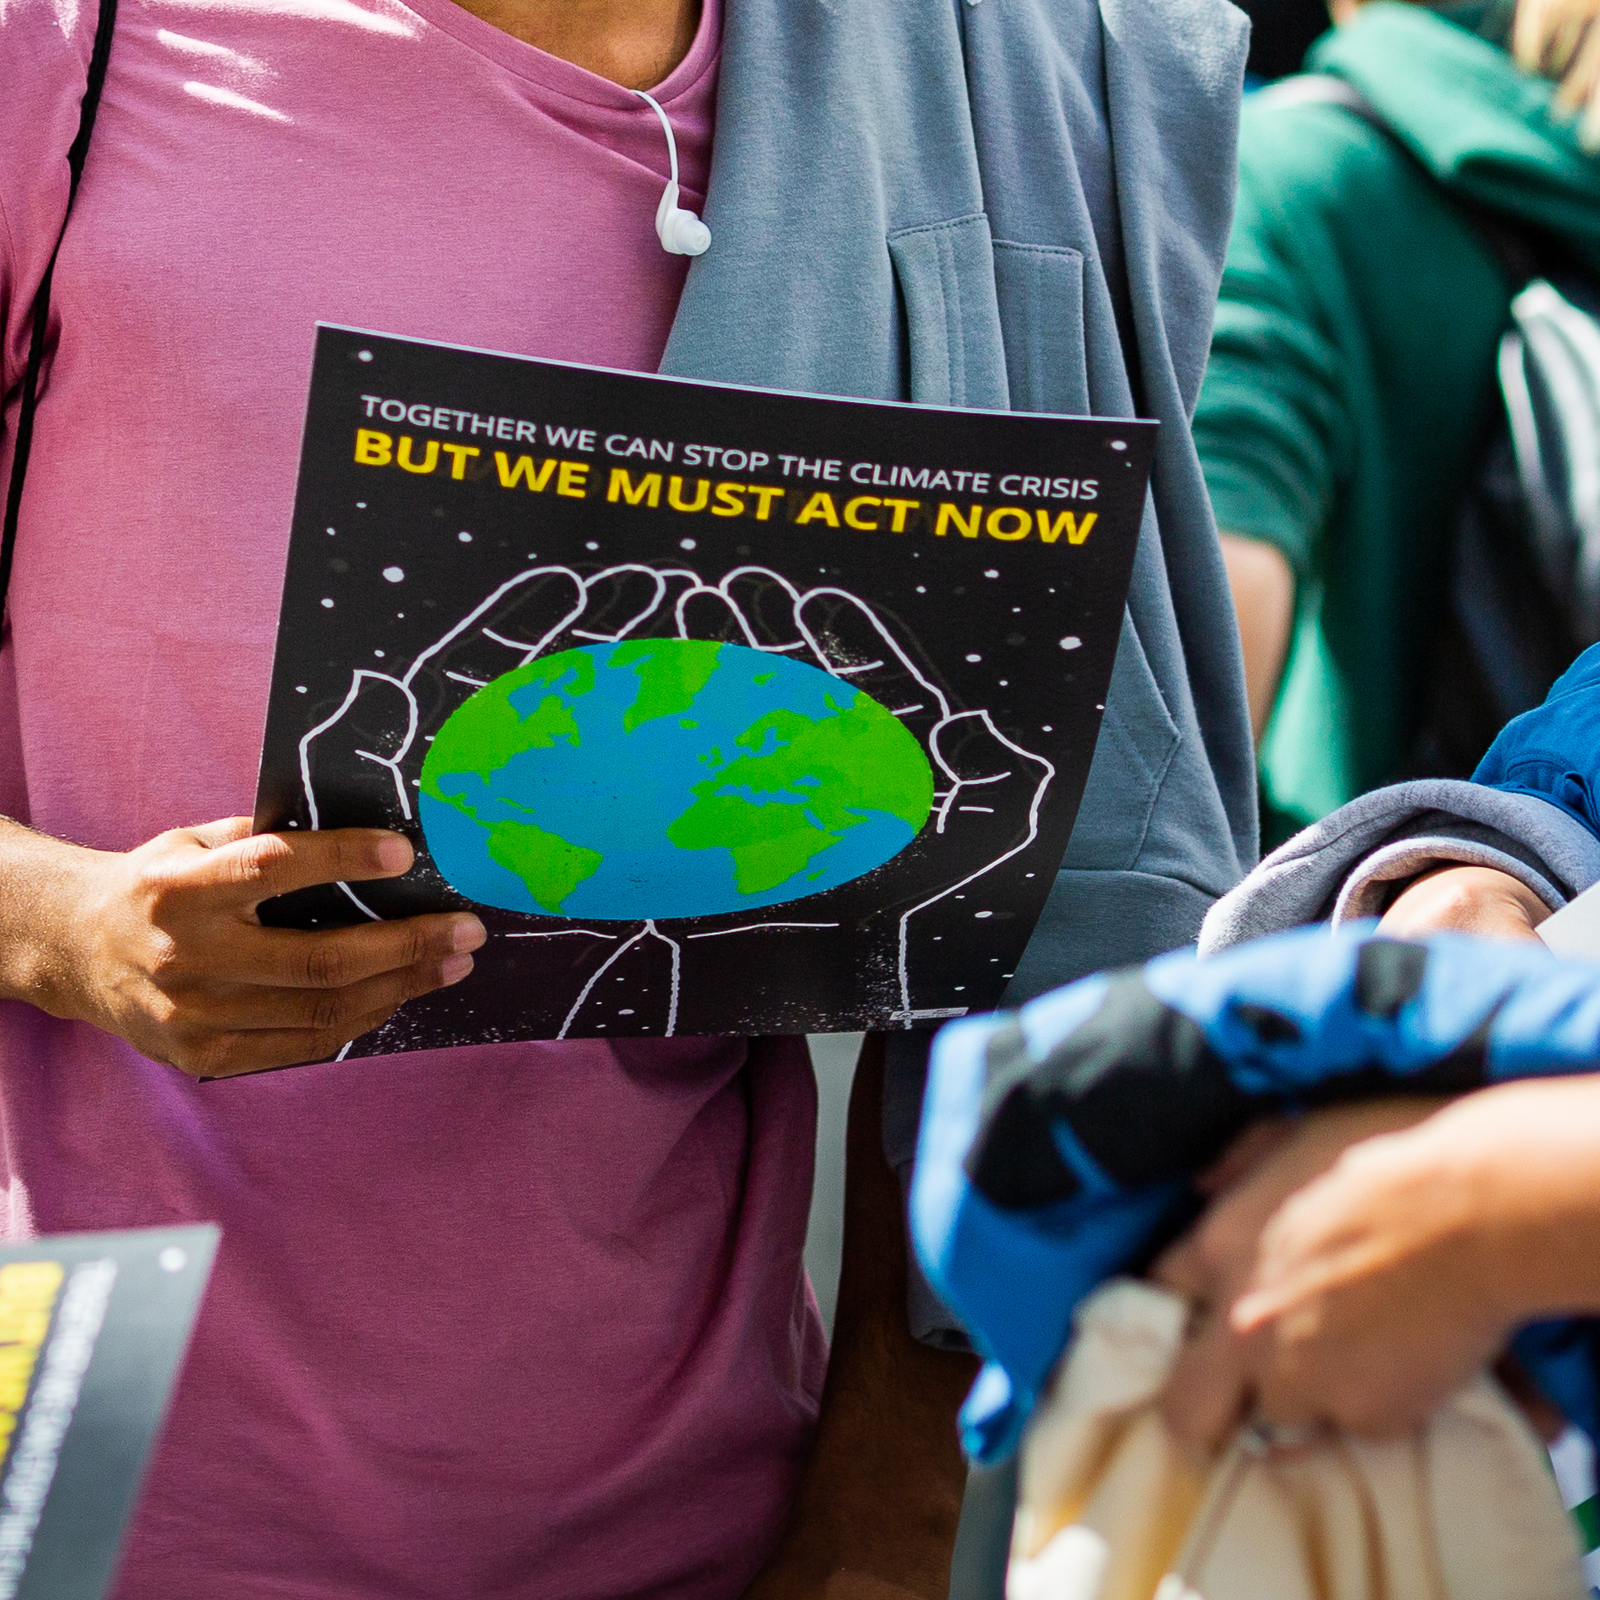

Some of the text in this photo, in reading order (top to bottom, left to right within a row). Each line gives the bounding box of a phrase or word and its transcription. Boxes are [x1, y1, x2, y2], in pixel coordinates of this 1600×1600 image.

[353, 427, 1098, 545] BUT WE MUST ACT NOW
[360, 394, 1099, 501] TOGETHER WE CAN STOP THE CLIMATE CRISIS
